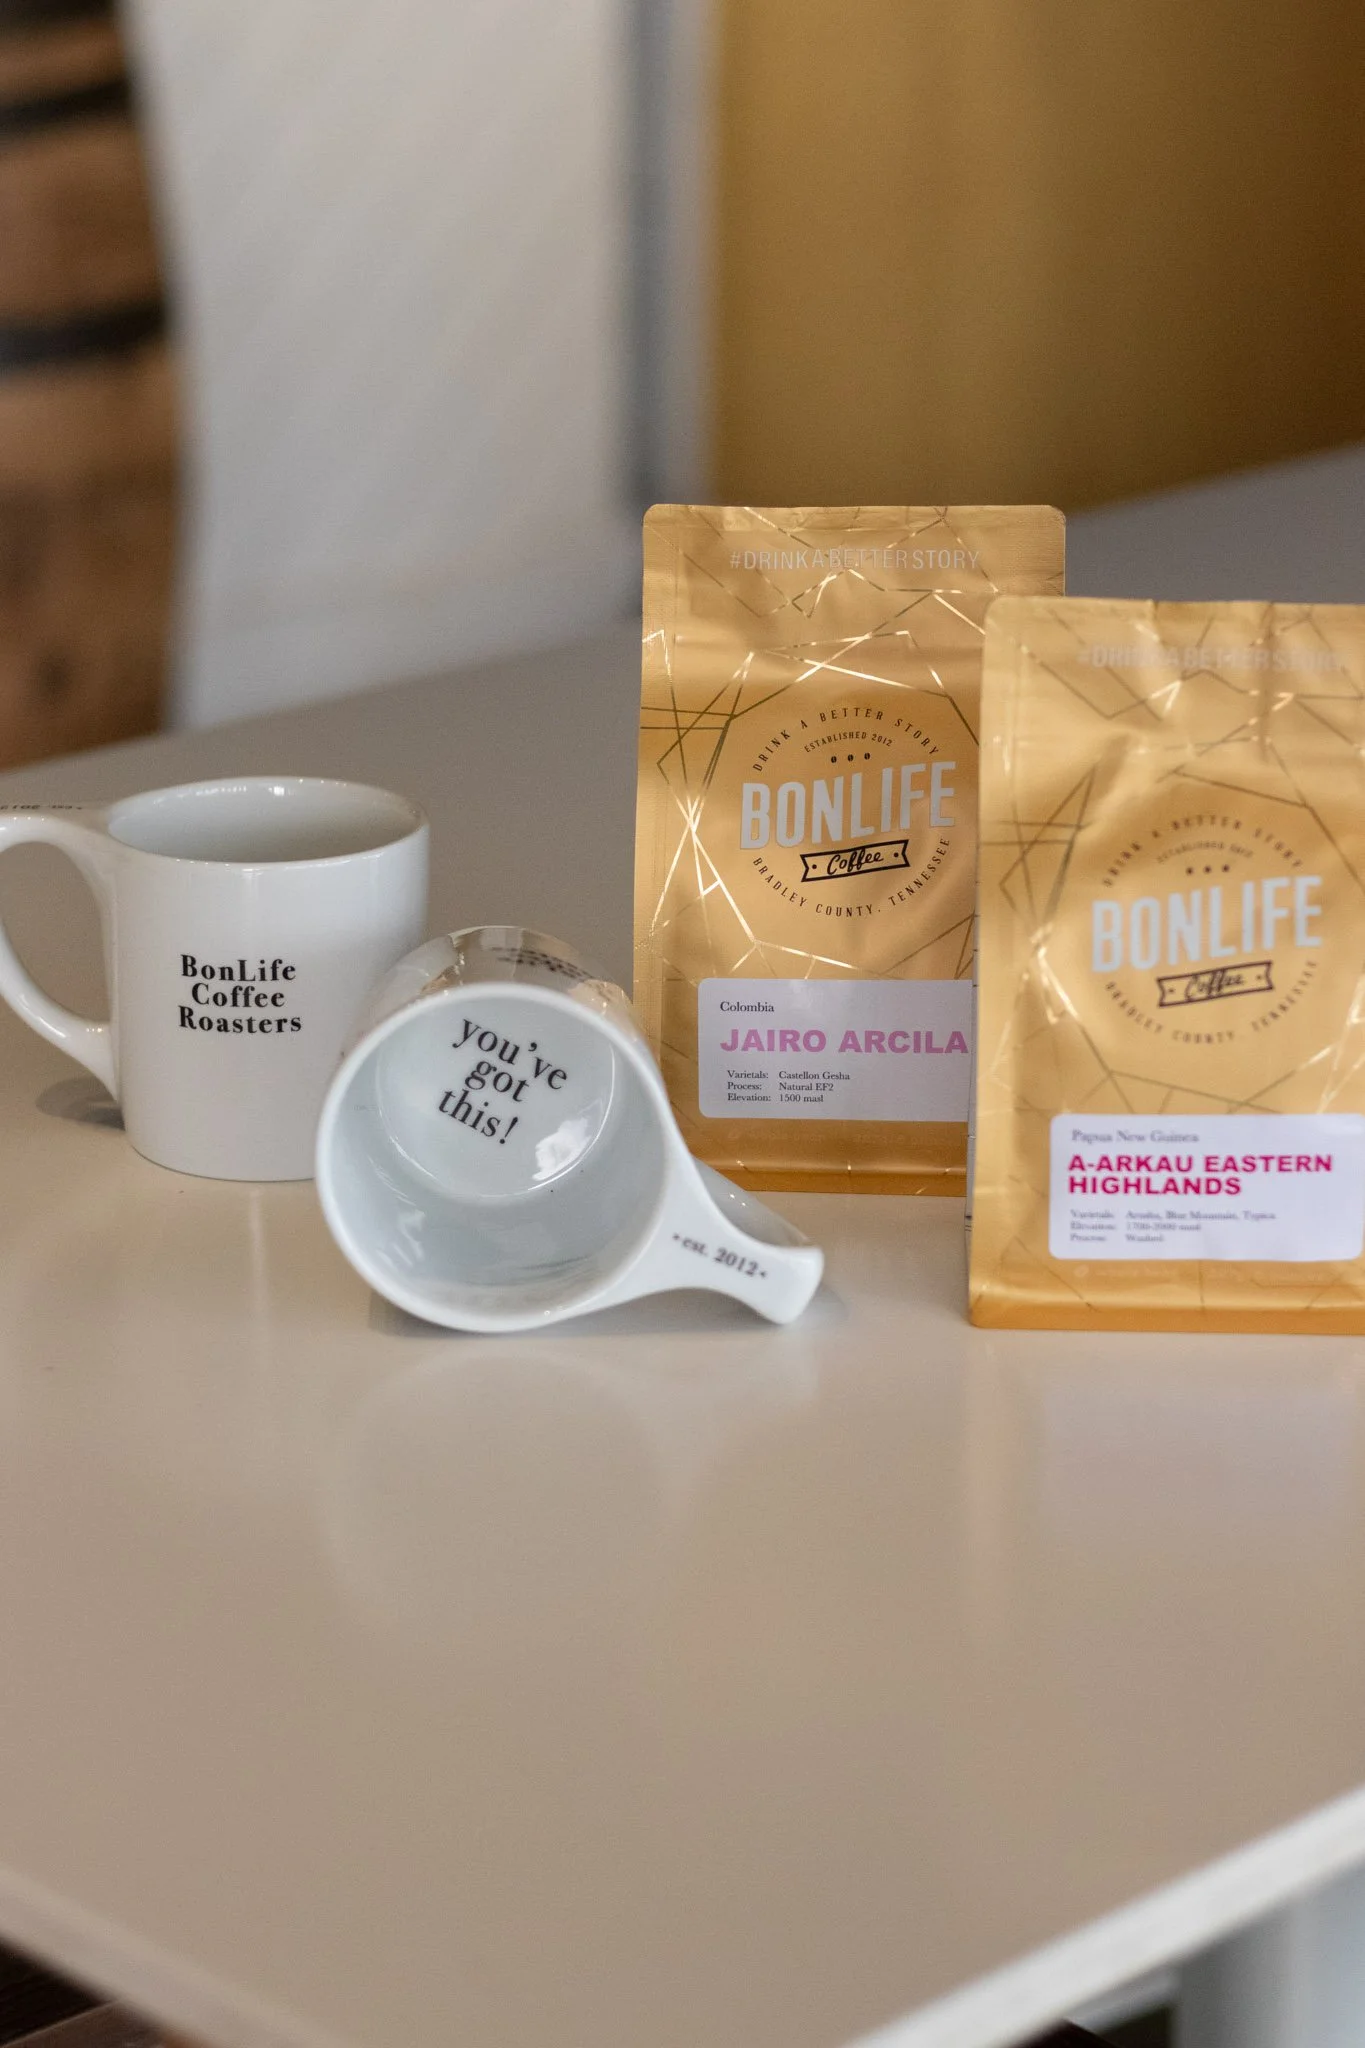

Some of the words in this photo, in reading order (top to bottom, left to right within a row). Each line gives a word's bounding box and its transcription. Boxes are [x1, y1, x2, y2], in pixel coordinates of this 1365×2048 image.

[752, 730, 791, 772] DRINK
[800, 719, 809, 729] A
[819, 707, 884, 722] BETTER
[894, 718, 940, 755] STORY
[804, 731, 868, 753] ESTABLISHED
[871, 733, 894, 748] 2012
[739, 760, 957, 851] BONLIFE
[752, 857, 808, 907] BRADLEY
[888, 838, 951, 906] TENNESSEE
[826, 847, 885, 876] Coffee
[1091, 875, 1322, 973] BONLIFE
[180, 954, 297, 982] BonLife
[191, 982, 285, 1008] Coffee
[1184, 969, 1245, 1001] Coffee
[178, 1005, 302, 1033] Roasters
[719, 1000, 775, 1013] Colombia
[719, 1028, 827, 1053] JAIRO
[837, 1030, 970, 1054] ARCILA
[464, 1060, 530, 1102] got
[727, 1070, 769, 1079] Varietals:
[778, 1070, 820, 1080] Castellon
[822, 1071, 851, 1081] Gesha
[727, 1082, 762, 1091] Process:
[778, 1082, 814, 1091] Natural
[815, 1082, 834, 1092] EF2
[727, 1093, 772, 1102] Elevation:
[779, 1093, 801, 1103] 1500
[803, 1093, 825, 1103] masl
[437, 1088, 520, 1145] this!
[1070, 1129, 1114, 1145] Papua
[1116, 1130, 1146, 1142] New
[1149, 1129, 1200, 1143] Guinea
[1067, 1154, 1194, 1173] A-ARKAU
[1203, 1154, 1334, 1173] EASTERN
[1067, 1175, 1243, 1196] HIGHLANDS
[682, 1237, 708, 1257] est.
[713, 1247, 759, 1278] 2012
